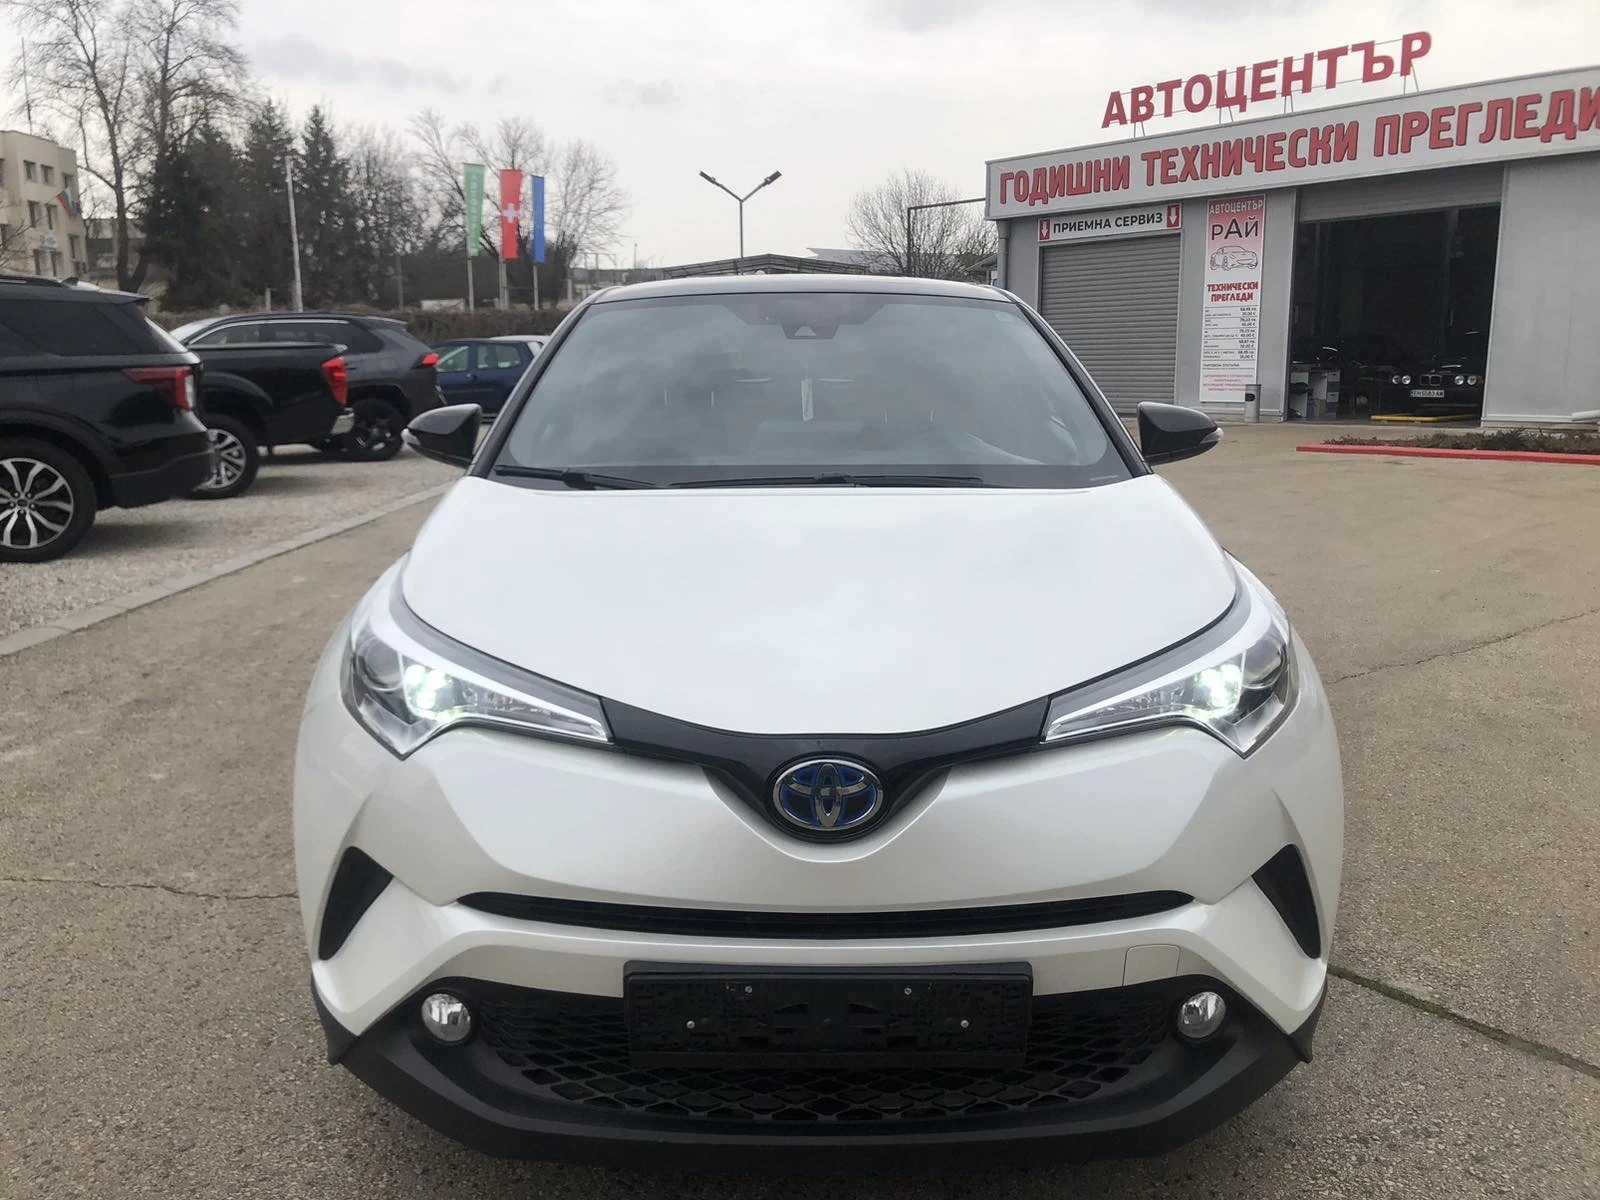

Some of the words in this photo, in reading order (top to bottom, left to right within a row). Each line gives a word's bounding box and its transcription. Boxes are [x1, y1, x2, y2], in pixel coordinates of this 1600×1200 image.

[1101, 30, 1433, 129] АВТОЦЕНТЪР
[999, 154, 1131, 206] ГОДИШНИ
[1140, 120, 1359, 188] ТЕХНИЧЕСКИ
[1373, 84, 1600, 158] ПРЕГЛЕДИ
[1209, 200, 1263, 214] АВТОЦЕНТЪР
[1052, 217, 1112, 234] ПРИЕМНА
[1114, 212, 1164, 229] СЕРВИЗ
[1211, 215, 1259, 241] РАЙ
[1207, 282, 1259, 292] ТЕХНИЧЕСКИ
[1211, 292, 1253, 302] ПРЕГЛЕДИ
